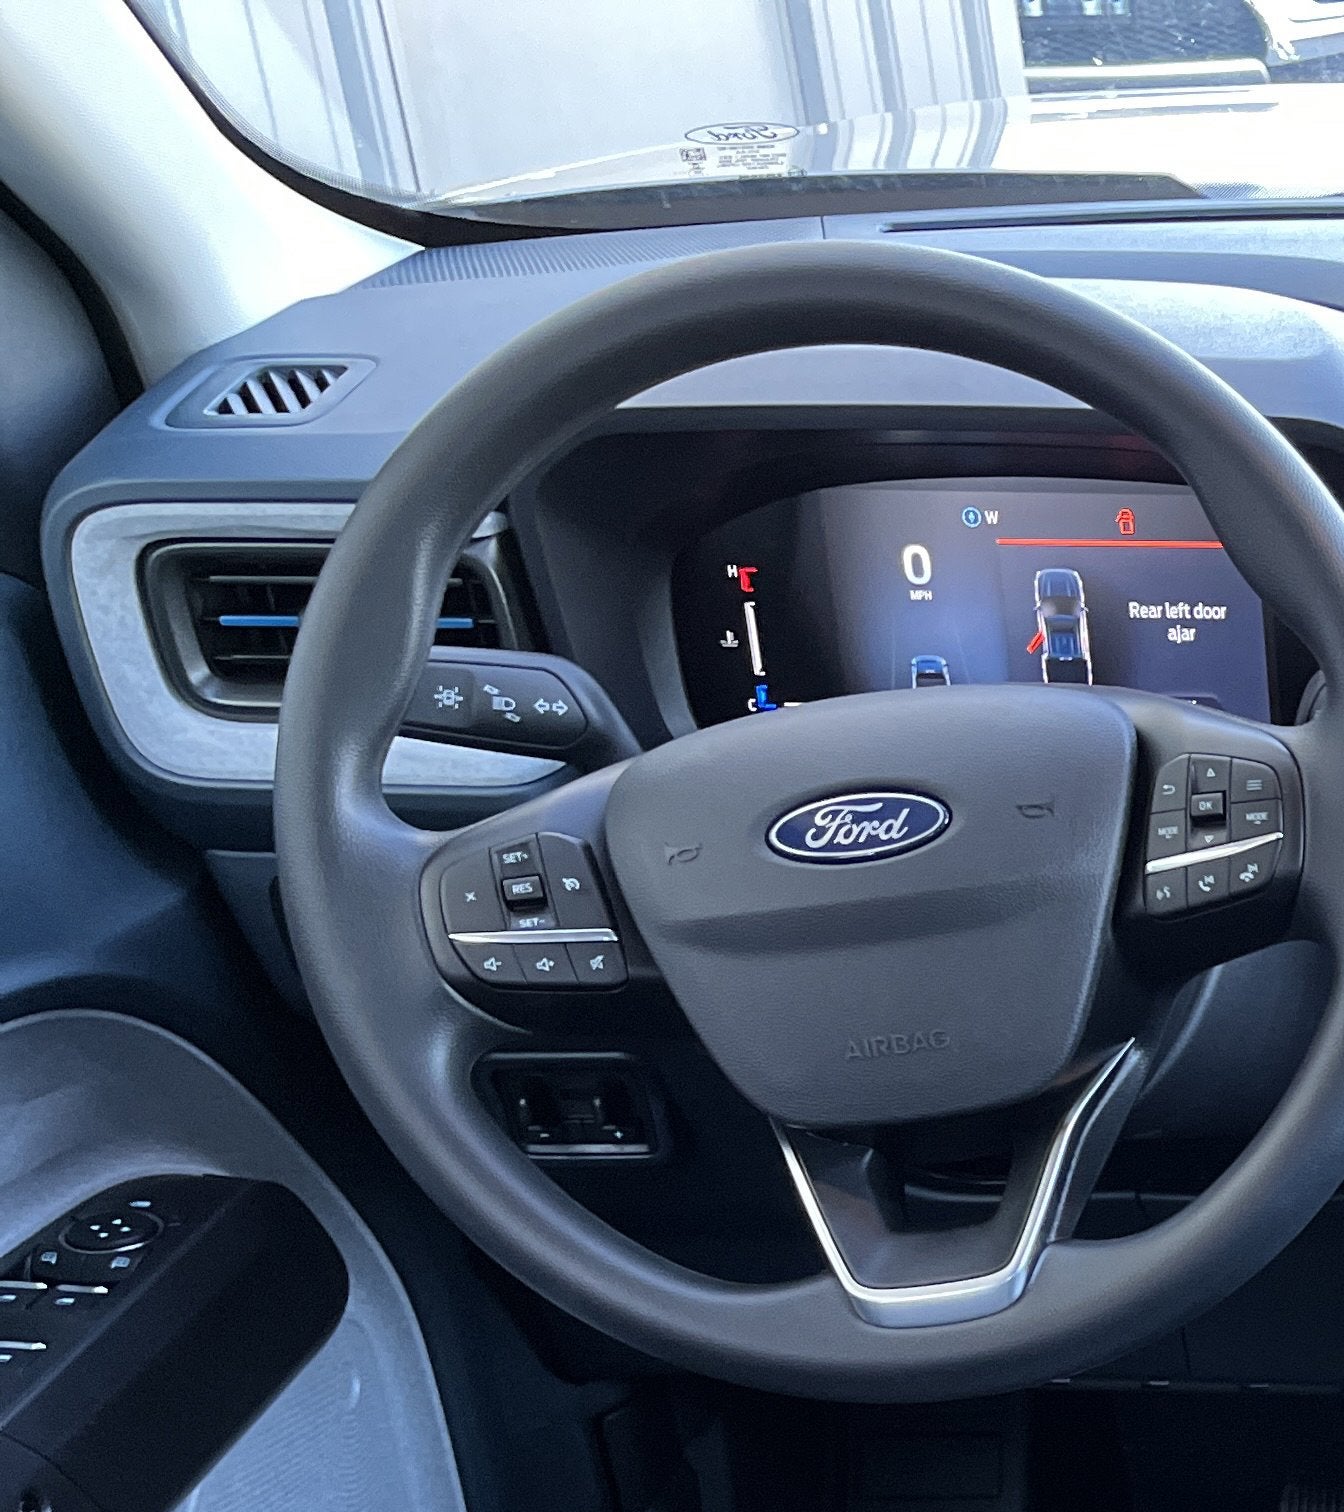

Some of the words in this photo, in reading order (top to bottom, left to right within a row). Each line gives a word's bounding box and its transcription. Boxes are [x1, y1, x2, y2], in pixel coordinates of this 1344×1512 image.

[984, 511, 998, 525] W
[727, 564, 738, 578] H
[902, 544, 933, 586] 0
[909, 590, 933, 600] MPH
[1128, 601, 1163, 619] Rear
[1165, 602, 1191, 619] left
[1193, 603, 1227, 620] door
[1167, 625, 1196, 644] ajar
[1199, 801, 1213, 811] OK
[804, 802, 910, 849] Ford
[511, 882, 533, 894] RES
[847, 1028, 950, 1059] AIRBAG
